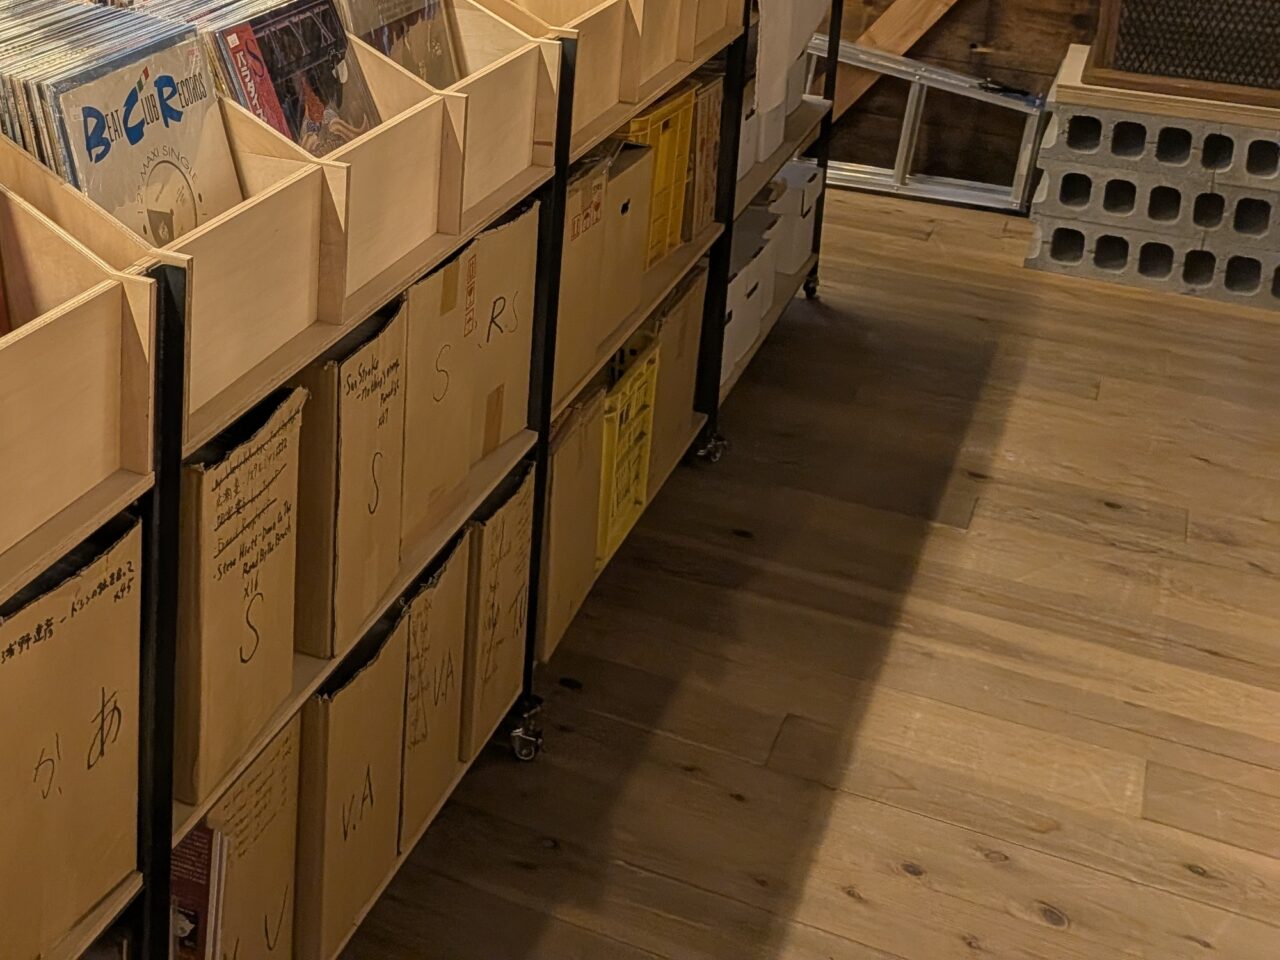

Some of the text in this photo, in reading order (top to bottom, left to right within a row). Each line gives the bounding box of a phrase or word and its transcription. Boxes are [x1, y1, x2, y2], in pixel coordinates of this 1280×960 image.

[140, 149, 161, 180] MAXI
[162, 145, 198, 184] SINGLE
[433, 344, 452, 402] S
[368, 451, 383, 515] S
[240, 593, 263, 664] S
[87, 687, 122, 770] あ
